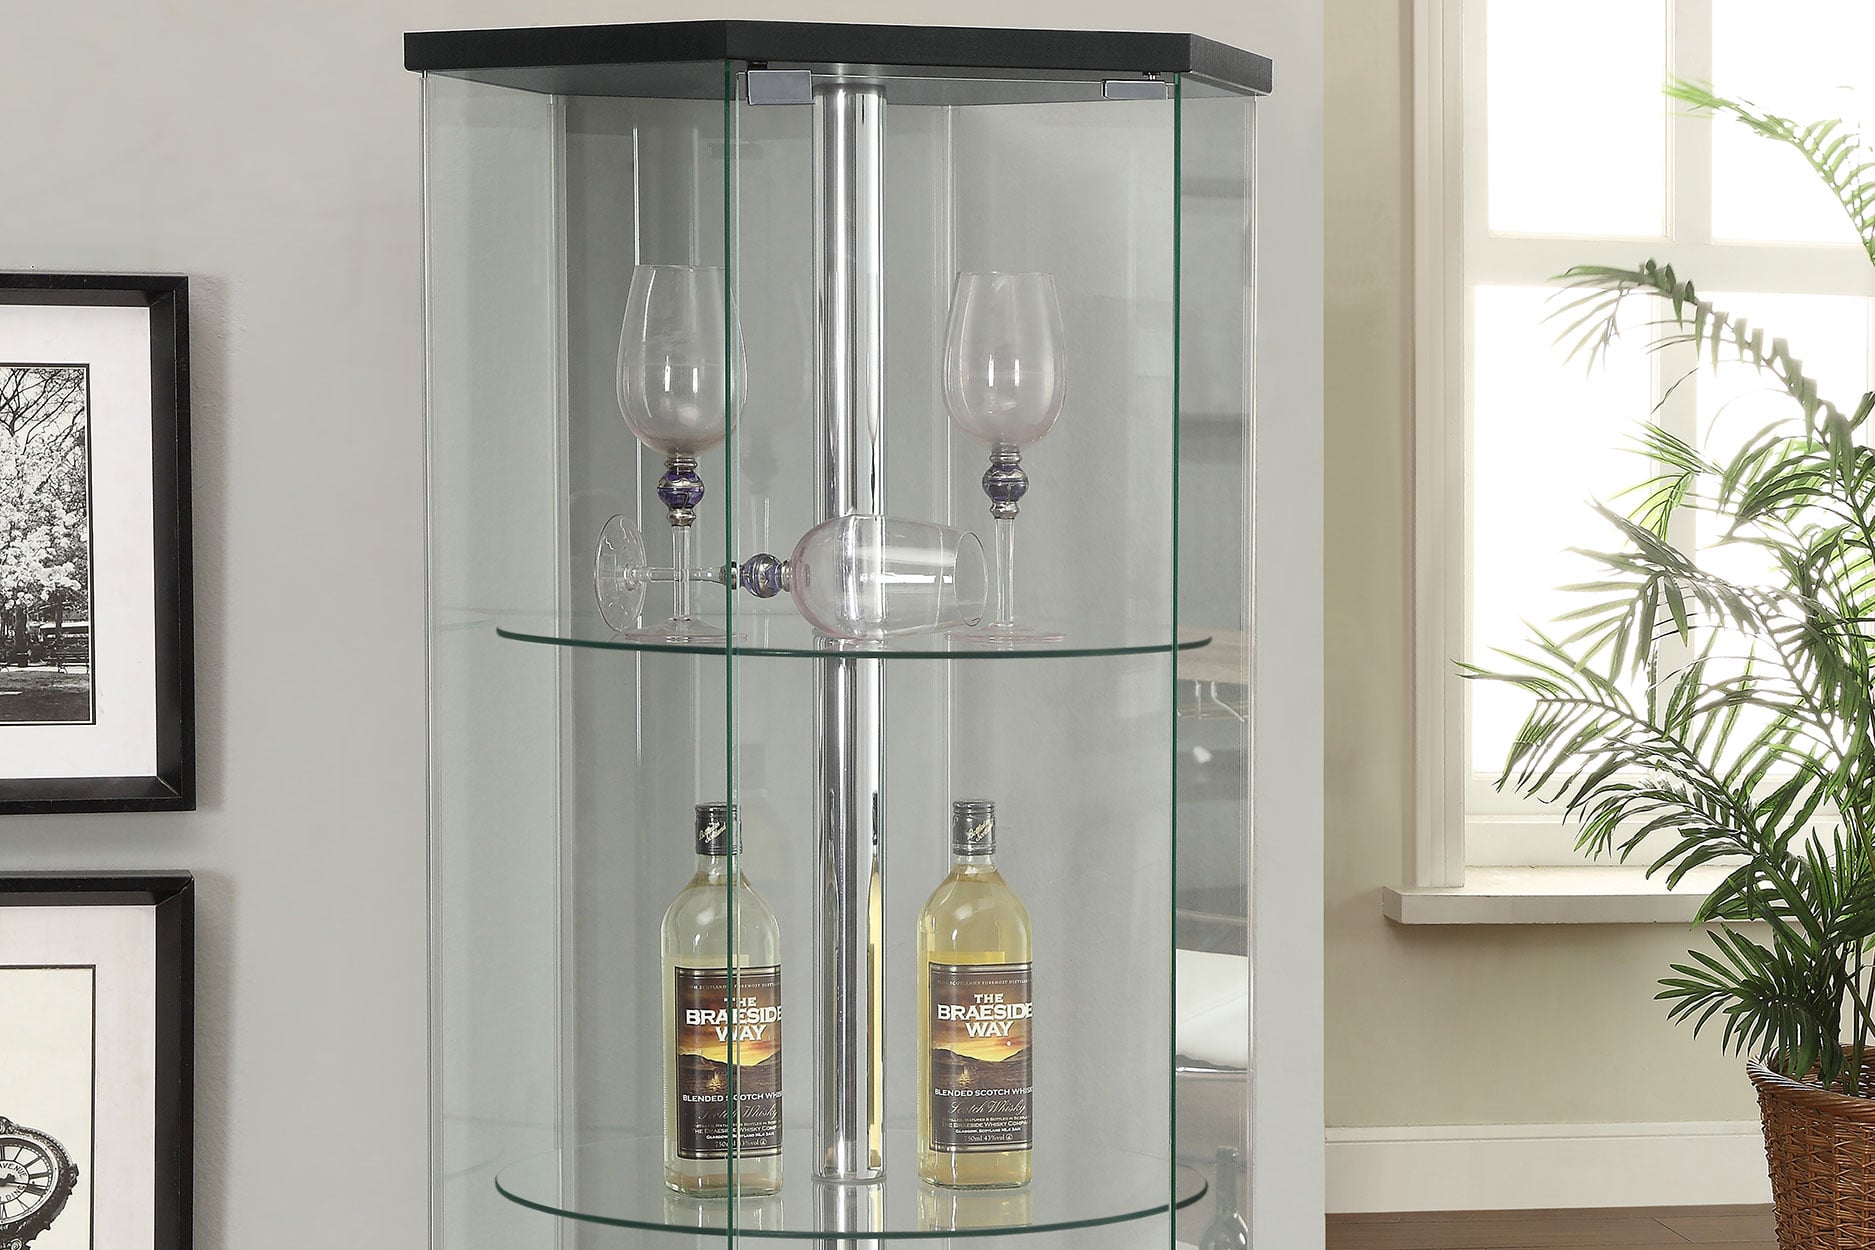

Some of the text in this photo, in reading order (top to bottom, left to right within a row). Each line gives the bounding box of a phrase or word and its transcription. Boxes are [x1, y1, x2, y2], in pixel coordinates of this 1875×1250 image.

[973, 993, 1004, 1004] THE
[714, 1024, 767, 1042] WAY
[965, 1020, 1014, 1038] WAY
[682, 1094, 724, 1103] BLENDED
[725, 1092, 764, 1102] COTCH
[934, 1088, 974, 1097] BLENDED
[974, 1088, 1010, 1097] SCOTCH
[986, 1098, 1026, 1115] Whisky
